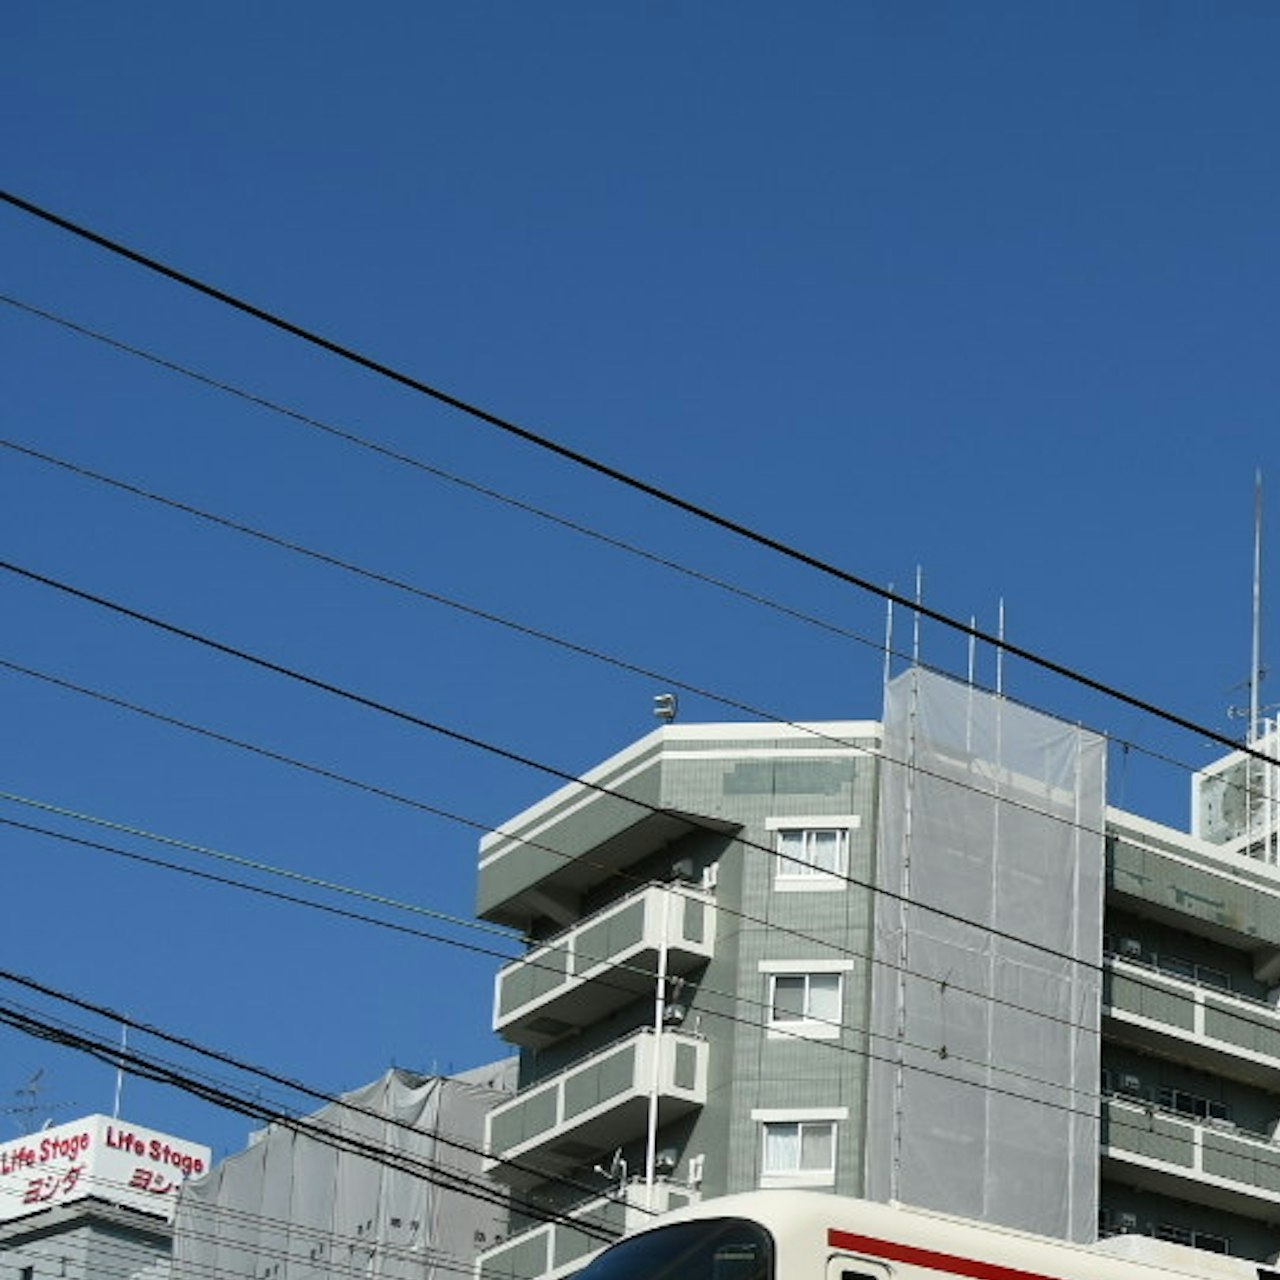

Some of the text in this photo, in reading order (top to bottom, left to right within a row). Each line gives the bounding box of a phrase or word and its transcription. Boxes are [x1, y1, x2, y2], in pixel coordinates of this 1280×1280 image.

[1, 1133, 89, 1175] Life Stage
[106, 1126, 204, 1174] Life Stage
